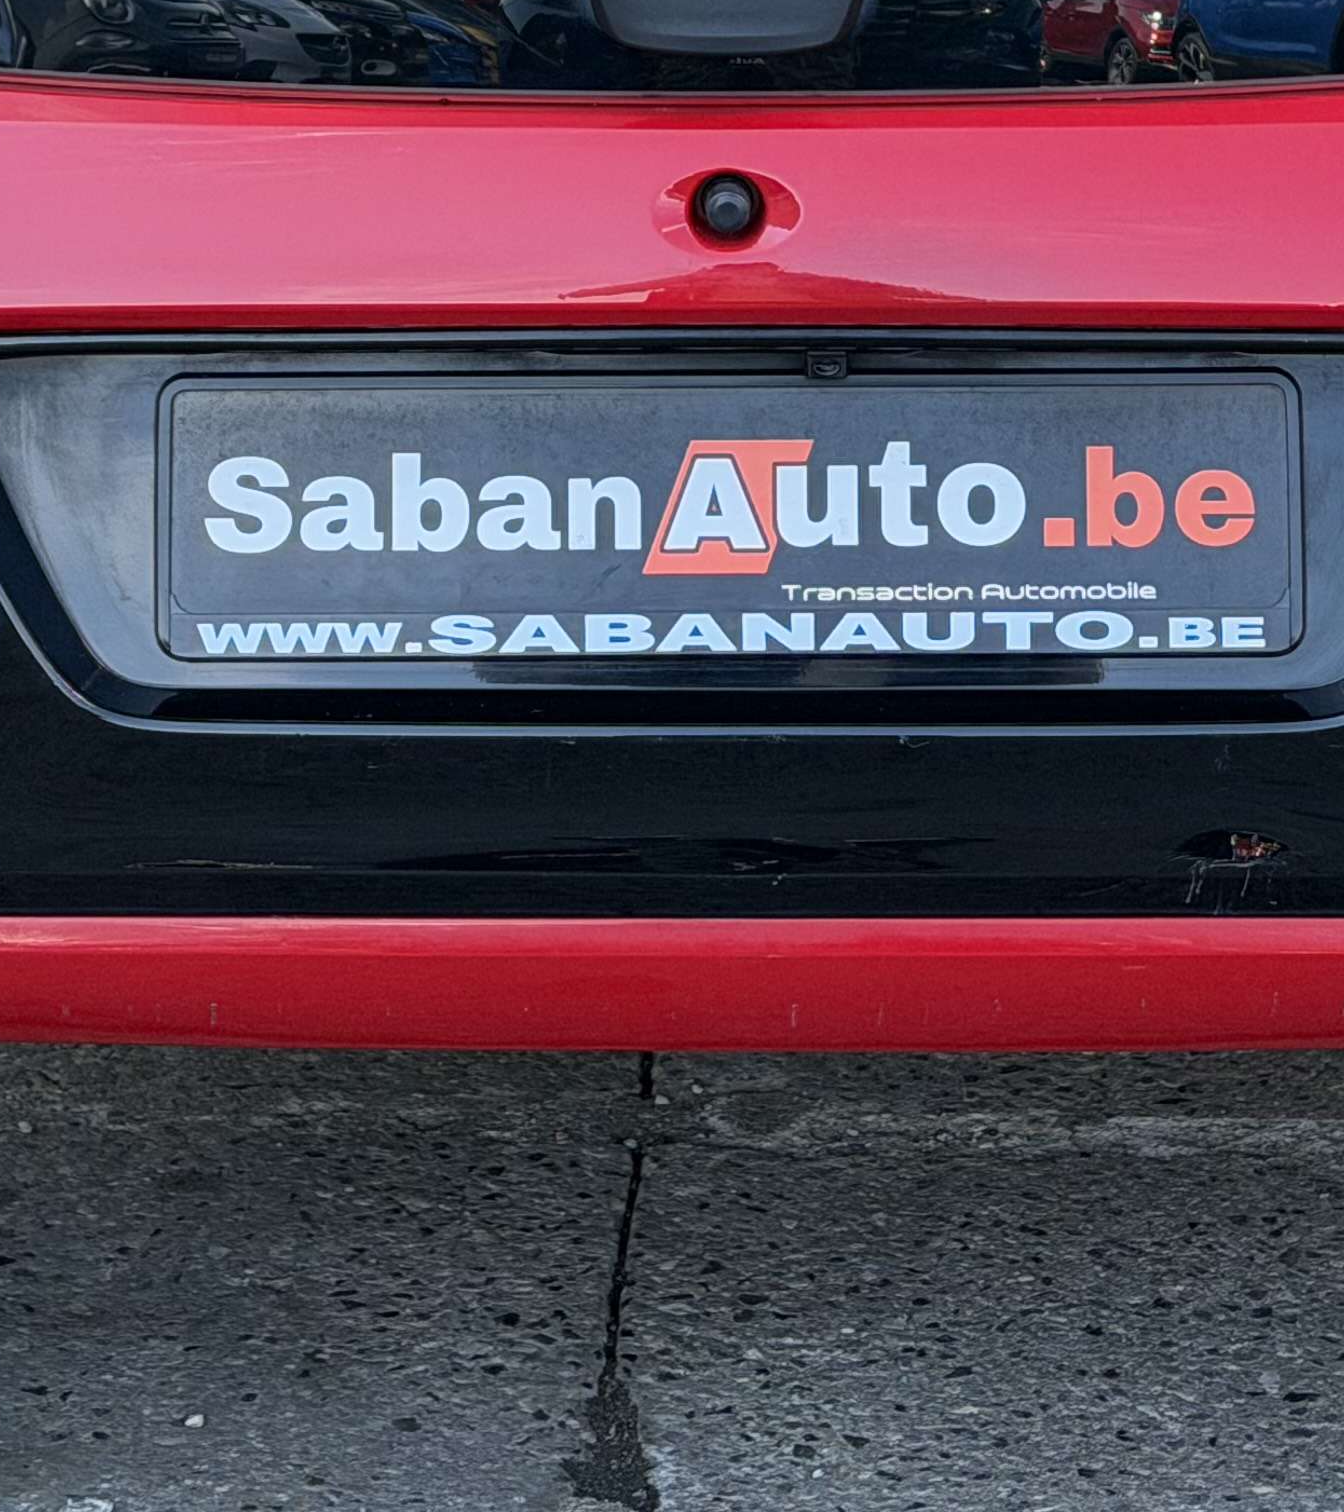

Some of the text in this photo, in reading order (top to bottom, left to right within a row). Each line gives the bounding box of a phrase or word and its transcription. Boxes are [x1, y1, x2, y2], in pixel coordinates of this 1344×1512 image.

[204, 440, 1256, 555] SabanAuto.be
[781, 582, 1157, 602] Transaction Automobile
